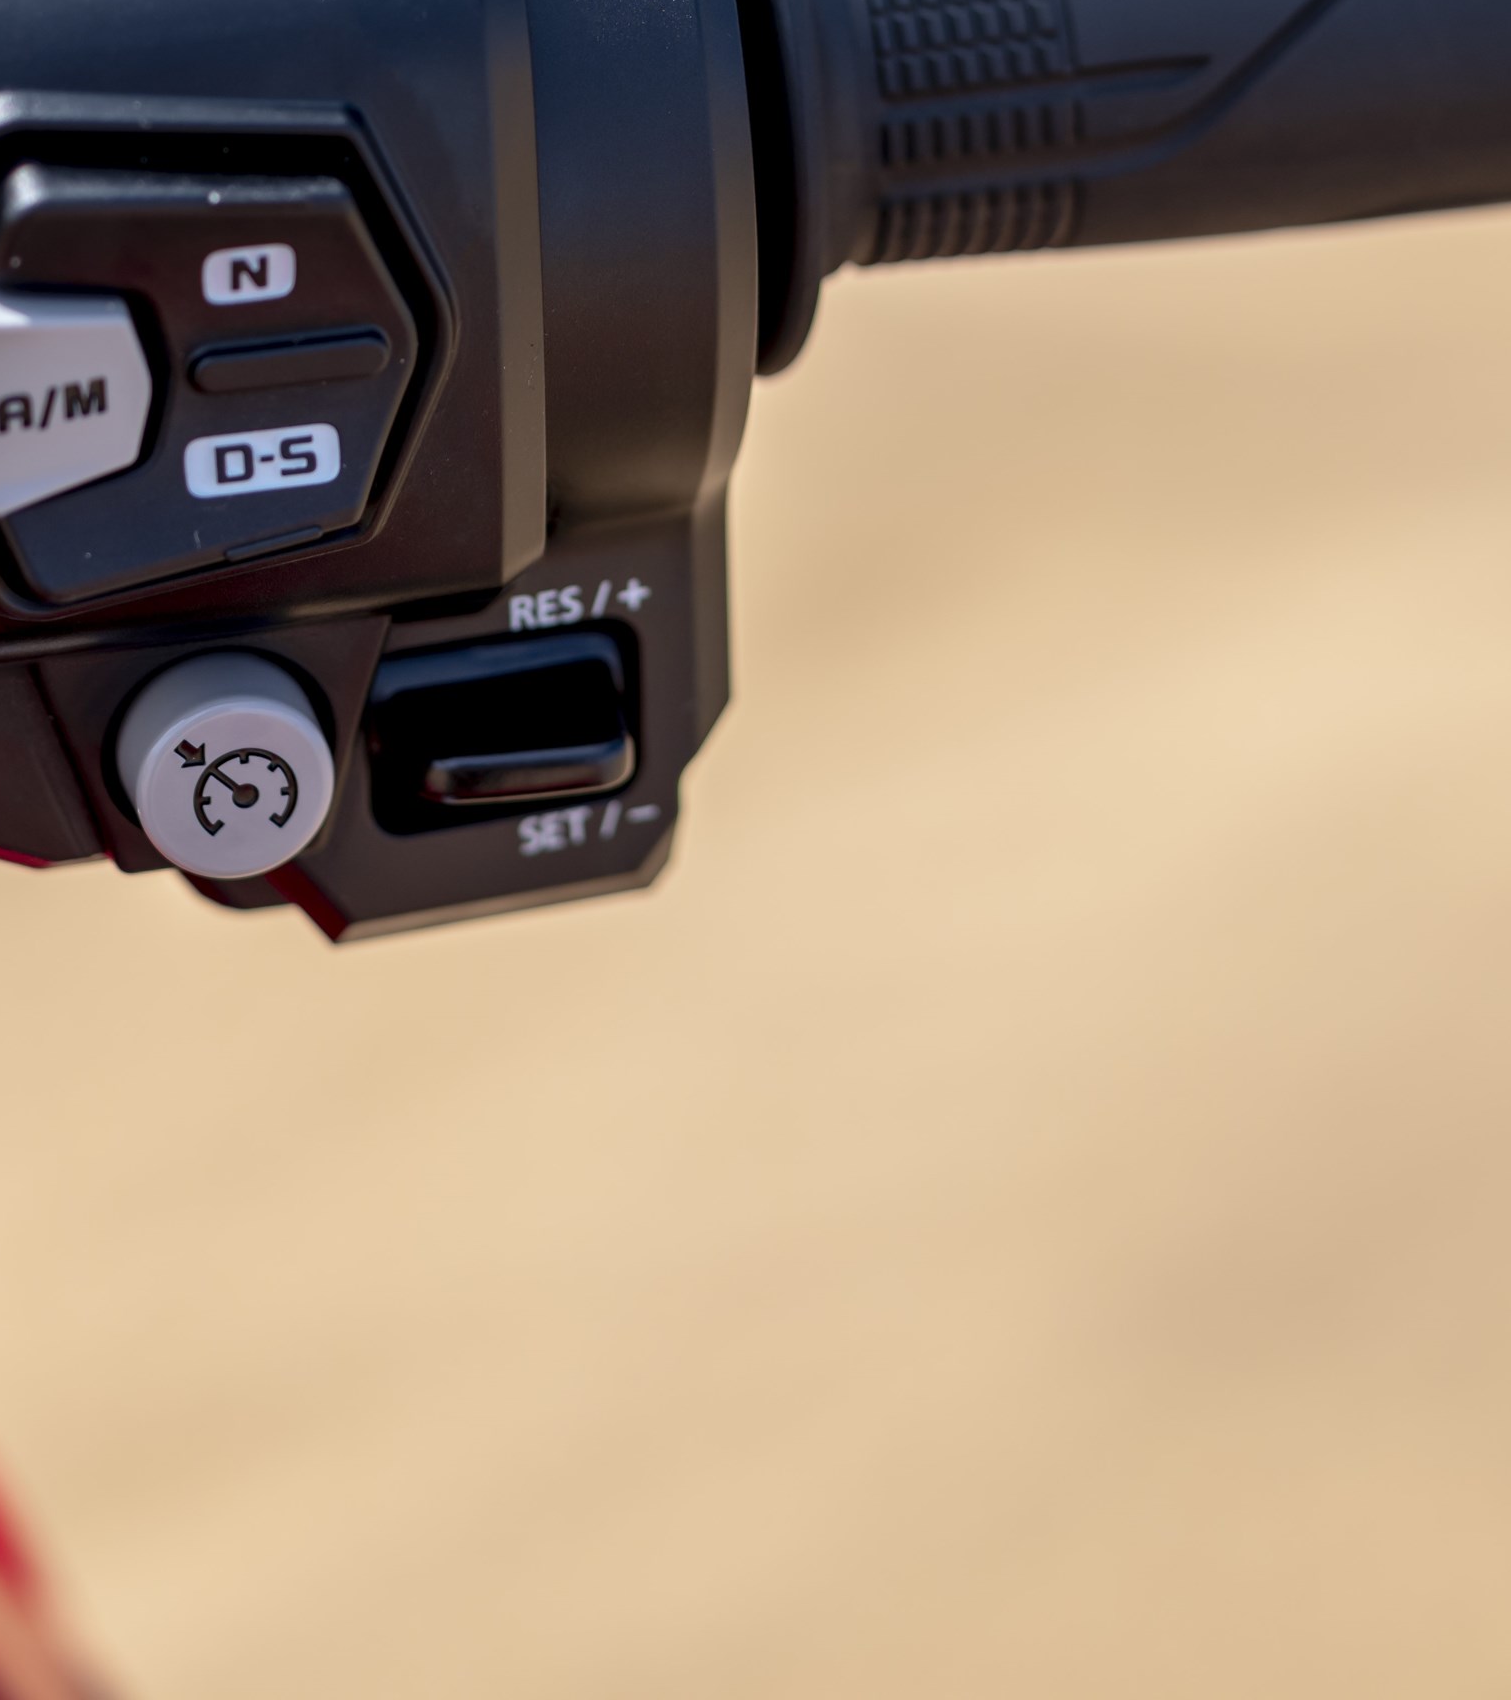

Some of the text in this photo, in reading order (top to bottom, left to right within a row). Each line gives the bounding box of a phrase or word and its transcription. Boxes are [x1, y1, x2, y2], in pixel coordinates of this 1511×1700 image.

[229, 254, 270, 292] N
[214, 434, 318, 485] D-S
[508, 584, 584, 631] RES
[517, 805, 593, 856] SET
